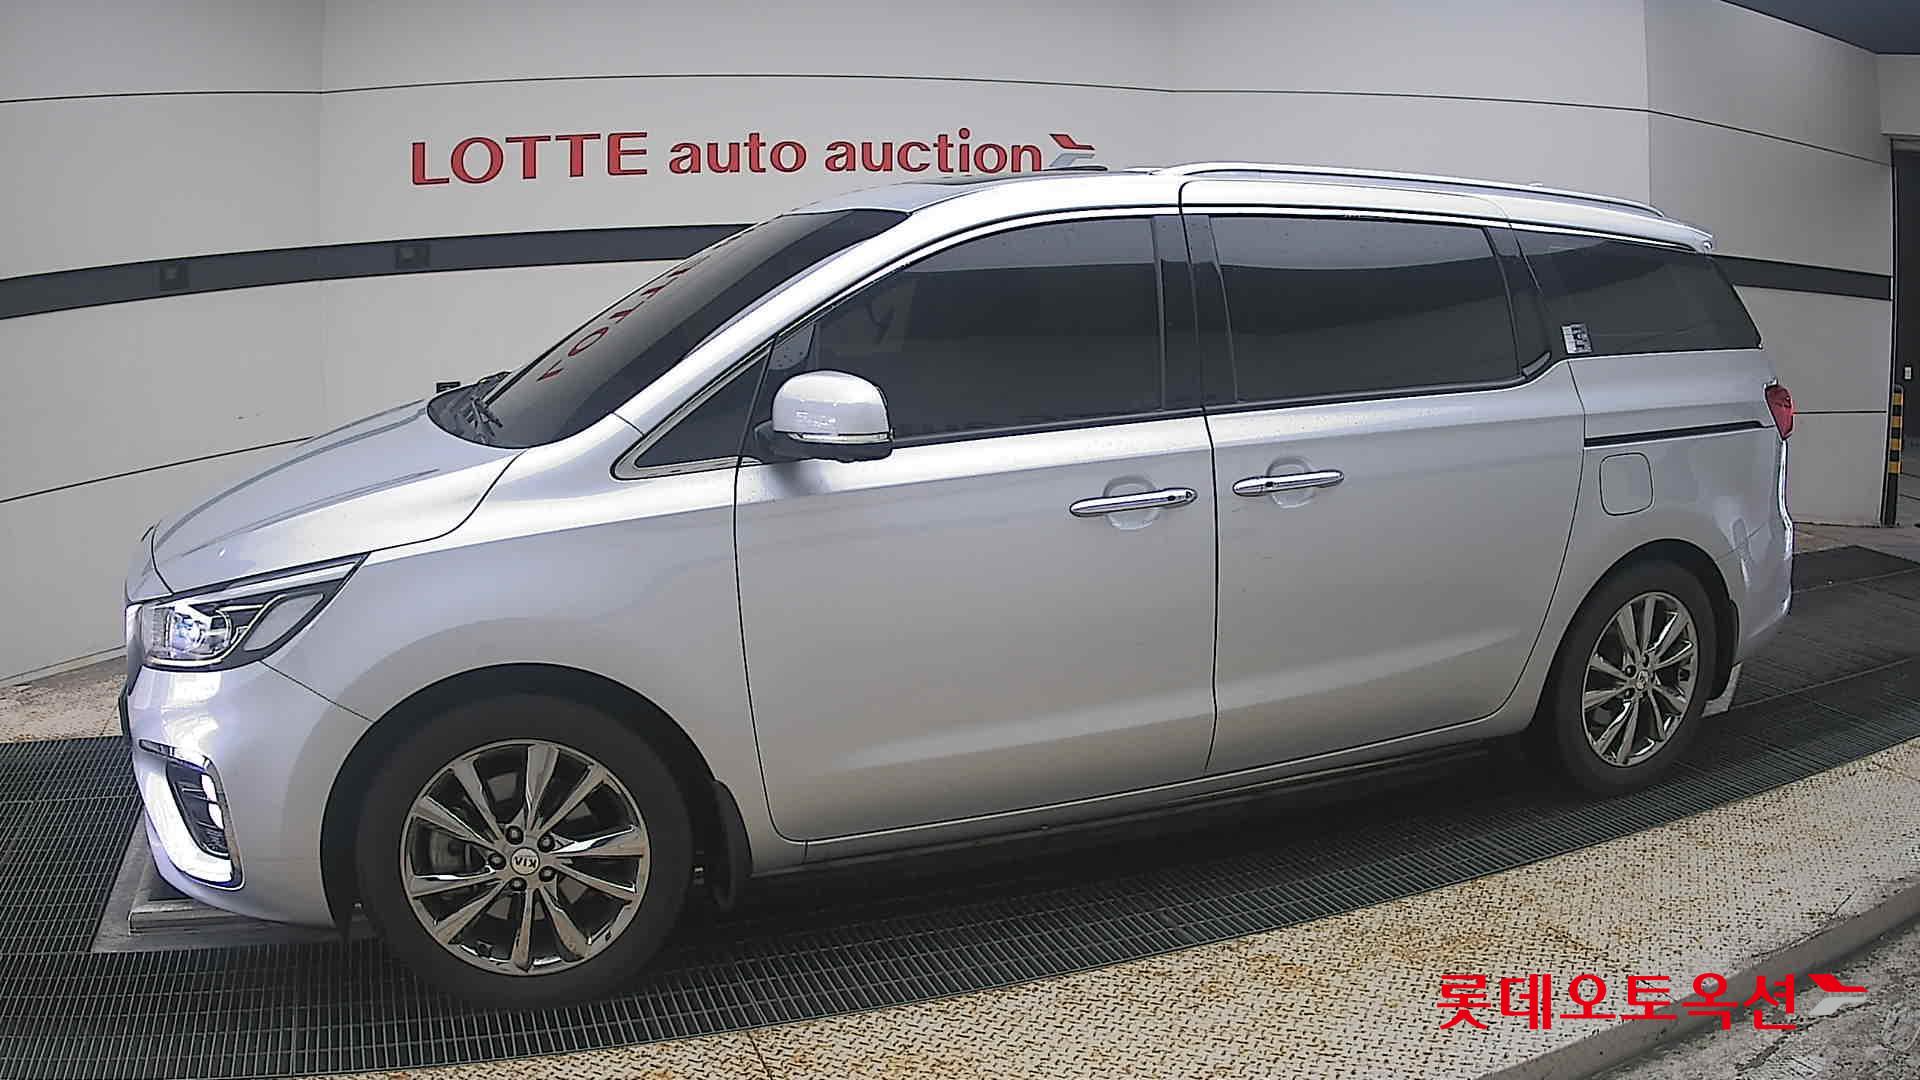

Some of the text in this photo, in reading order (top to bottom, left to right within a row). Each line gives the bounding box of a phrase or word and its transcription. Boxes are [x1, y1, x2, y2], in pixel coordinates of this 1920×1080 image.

[412, 127, 1042, 186] LOTTE auto auction
[513, 856, 537, 869] KIA
